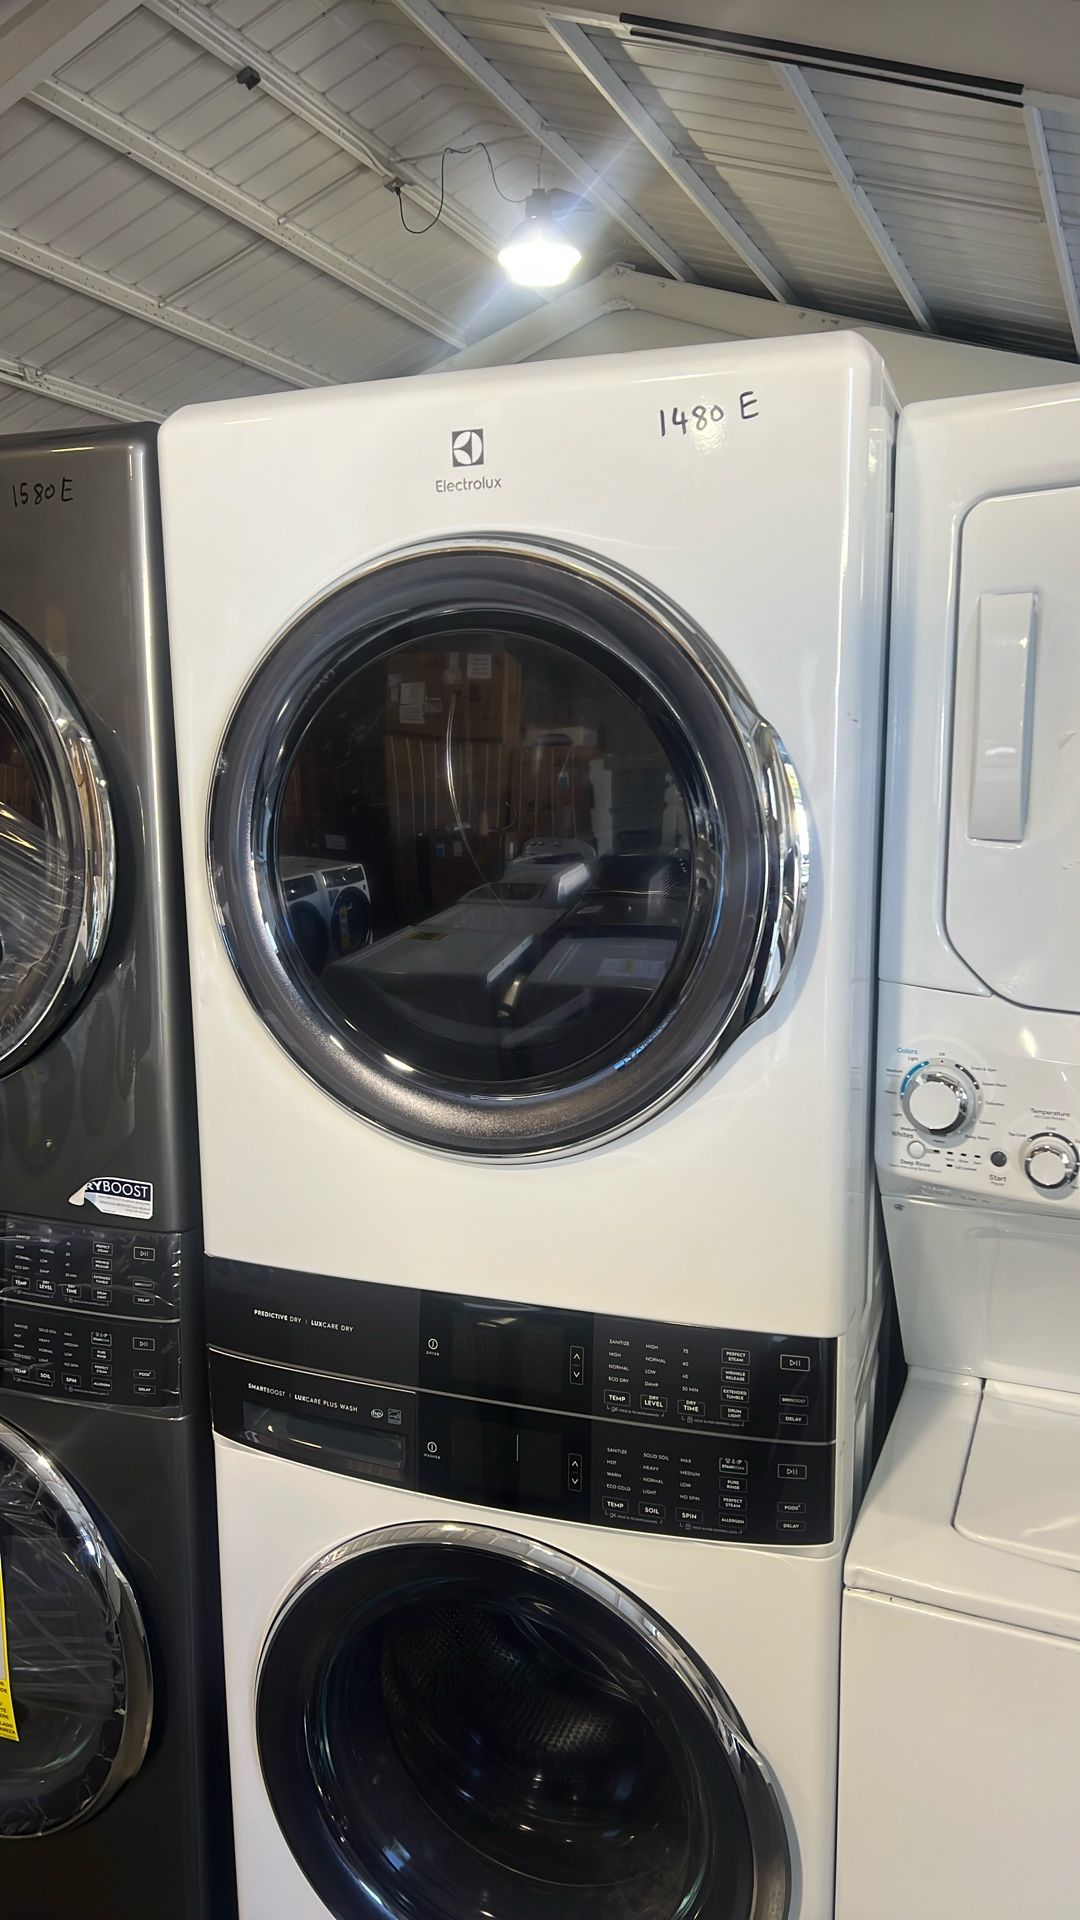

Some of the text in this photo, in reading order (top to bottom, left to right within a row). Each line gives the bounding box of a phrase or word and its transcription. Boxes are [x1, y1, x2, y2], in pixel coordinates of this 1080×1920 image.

[659, 391, 760, 437] 1480 E
[435, 476, 503, 493] Electrolux
[897, 1047, 918, 1055] Colors
[1030, 1108, 1070, 1117] Temperature
[892, 1130, 914, 1139] Whites
[989, 1174, 1007, 1182] Start
[254, 1309, 354, 1333] PREDICTIVE DRY LUXCARE DRY
[645, 1356, 666, 1364] NORMAL
[248, 1382, 358, 1412] SMARTBOOST LUXCARE PLUS WASH
[608, 1394, 626, 1402] TEMP
[644, 1400, 663, 1408] LEVEL
[607, 1447, 628, 1455] SANITIZE
[644, 1507, 659, 1515] SOIL
